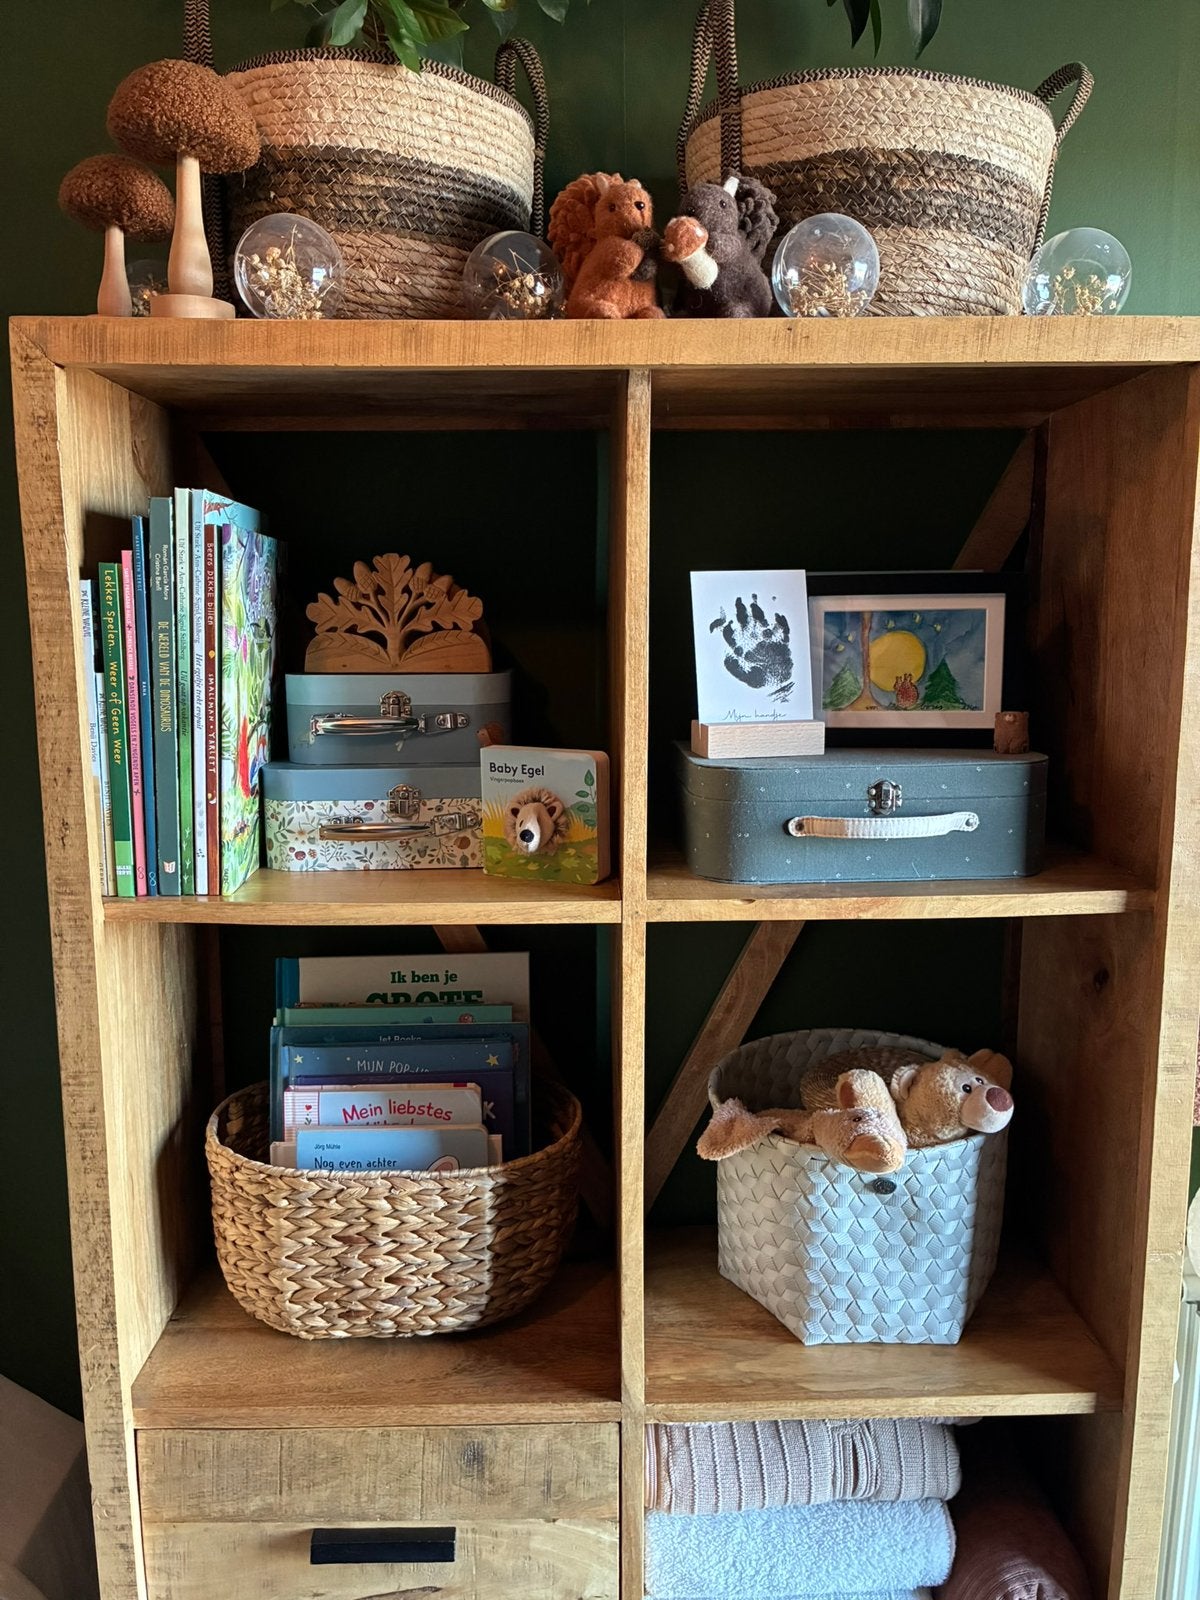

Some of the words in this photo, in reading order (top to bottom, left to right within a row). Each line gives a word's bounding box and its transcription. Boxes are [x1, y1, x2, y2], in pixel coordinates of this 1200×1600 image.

[194, 521, 202, 533] Ulf
[178, 538, 186, 549] Ulf
[194, 533, 202, 549] Stark
[207, 542, 215, 566] Beers
[154, 553, 162, 575] Cristina
[194, 553, 202, 596] Ann-Cathrine
[207, 570, 215, 597] DIKKE
[104, 568, 116, 607] Lekker
[193, 596, 202, 615] Sigrid
[207, 602, 215, 626] billen
[157, 621, 169, 630] DE
[178, 613, 187, 632] Sigrid
[103, 610, 118, 657] Spelen...
[158, 632, 170, 659] WERELD
[159, 660, 171, 676] VAN
[195, 653, 203, 666] Het
[109, 661, 118, 688] Weer
[159, 678, 171, 687] DE
[180, 670, 188, 682] Uil
[194, 667, 203, 688] egeltje
[109, 691, 121, 704] of
[179, 682, 188, 698] gaat
[159, 689, 172, 732] DINOSAURUS
[179, 698, 187, 707] op
[111, 707, 122, 735] Geen
[180, 707, 189, 737] vakantie
[194, 705, 204, 730] eropuit
[754, 708, 787, 722] handje
[131, 734, 137, 742] EN
[90, 741, 98, 762] Davies
[113, 738, 122, 765] Weer
[208, 731, 216, 774] YARLETT
[489, 762, 518, 777] Baby
[521, 764, 545, 779] Egel
[390, 971, 407, 984] Ik
[411, 970, 440, 983] ben
[443, 969, 458, 985] je
[356, 1060, 385, 1072] MIJN
[342, 1103, 383, 1124] Mein
[388, 1098, 454, 1121] liebstes
[313, 1143, 325, 1151] Jörg
[314, 1156, 335, 1170] Nog
[338, 1160, 362, 1169] even
[366, 1156, 398, 1169] achter
